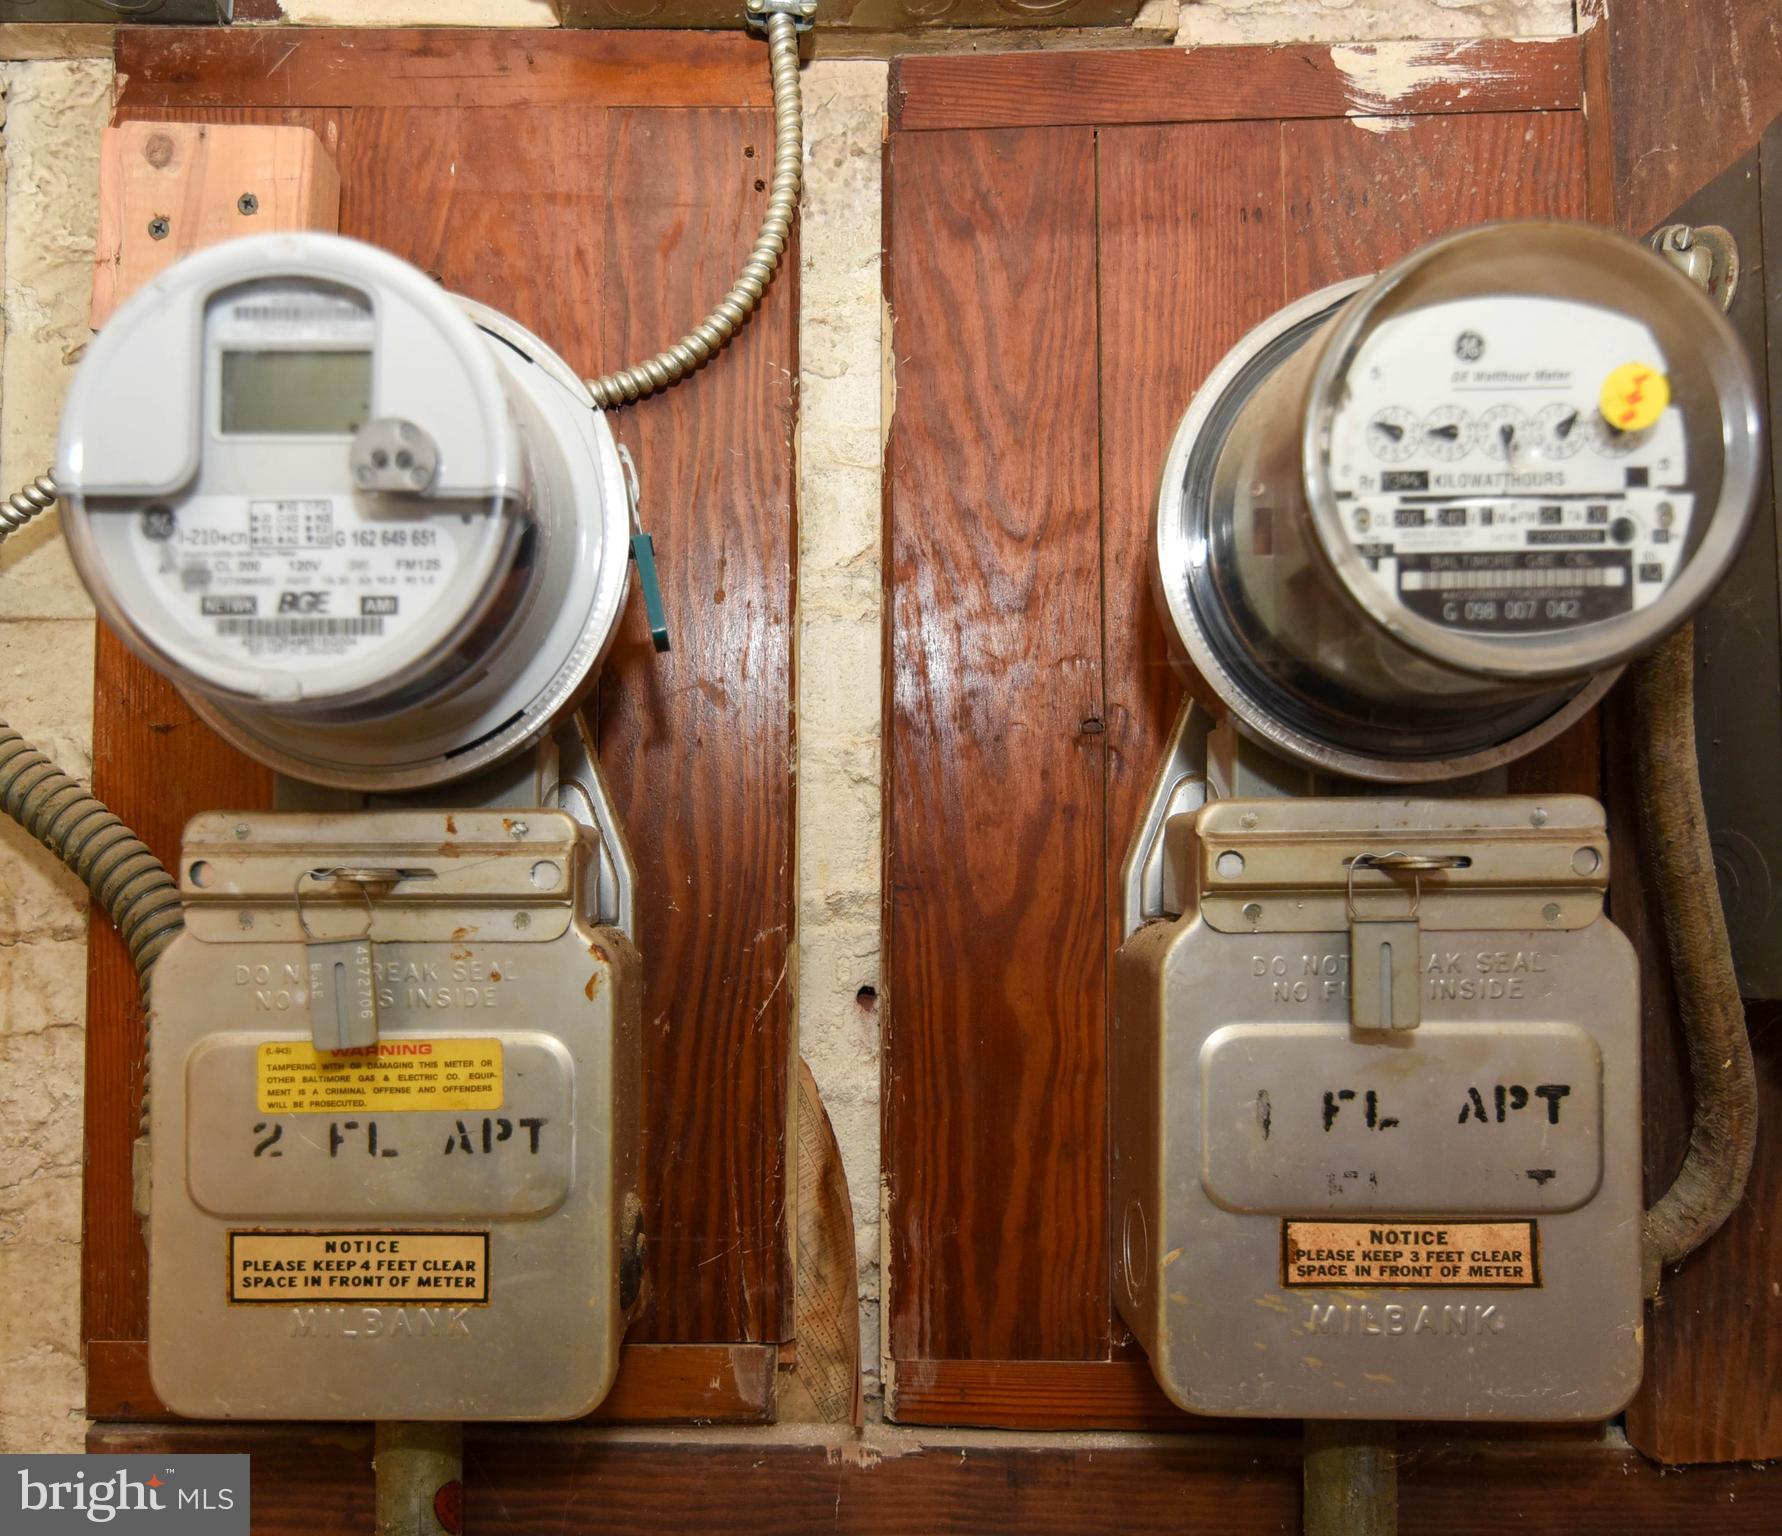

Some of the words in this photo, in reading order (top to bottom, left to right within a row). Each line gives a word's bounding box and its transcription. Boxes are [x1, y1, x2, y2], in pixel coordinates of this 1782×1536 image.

[1434, 472, 1565, 489] KILOWATTHOURS
[336, 530, 346, 547] G
[351, 530, 377, 547] 162
[381, 530, 408, 547] 649
[411, 530, 437, 547] 651
[1430, 554, 1515, 570] BALTIMORE
[277, 590, 332, 614] BGE
[364, 597, 396, 613] AMI
[1443, 602, 1457, 620] G
[1464, 602, 1496, 620] 098
[1504, 601, 1537, 619] 007
[1545, 600, 1579, 618] 042
[1252, 955, 1288, 976] DO
[1476, 952, 1547, 974] SEAL
[235, 963, 270, 985] DO
[374, 962, 438, 982] REAK
[452, 961, 518, 982] SEAL
[355, 945, 374, 1018] 4572706
[1272, 980, 1309, 1002] NO
[1430, 978, 1524, 1000] INSIDE
[256, 989, 290, 1012] NO
[407, 987, 497, 1009] INSIDE
[332, 1043, 433, 1057] WARNING
[266, 1063, 317, 1072] TAMPERING
[322, 1062, 345, 1071] WITH
[350, 1062, 362, 1070] OR
[367, 1061, 414, 1070] DAMAGING
[419, 1060, 439, 1069] THIS
[444, 1060, 474, 1068] METER
[480, 1059, 493, 1068] OR
[266, 1076, 295, 1084] OTHER
[302, 1075, 351, 1083] BALTIMORE
[358, 1074, 375, 1082] GAS
[383, 1074, 390, 1082] &
[398, 1073, 438, 1082] ELECTRIC
[446, 1073, 461, 1081] CO.
[469, 1072, 498, 1080] EQUIP-
[267, 1089, 291, 1097] MENT
[299, 1088, 306, 1096] IS
[325, 1087, 367, 1095] CRIMINAL
[373, 1087, 411, 1095] OFFENSE
[418, 1086, 436, 1094] AND
[442, 1085, 493, 1093] OFFENDERS
[267, 1101, 288, 1109] WILL
[293, 1100, 304, 1108] BE
[309, 1099, 367, 1108] PROSECUTED.
[1322, 1088, 1400, 1132] FL
[1458, 1084, 1572, 1125] APT
[253, 1121, 284, 1159] 2
[329, 1121, 399, 1159] FL
[444, 1117, 549, 1156] APT
[1369, 1229, 1449, 1245] NOTICE
[324, 1239, 401, 1254] NOTICE
[1295, 1250, 1356, 1262] PLEASE
[1362, 1250, 1404, 1262] KEEP
[1409, 1251, 1421, 1262] 3
[1426, 1250, 1465, 1262] FEET
[1470, 1251, 1523, 1262] CLEAR
[242, 1260, 307, 1272] PLEASE
[313, 1260, 357, 1272] KEEP
[360, 1260, 372, 1272] 4
[376, 1260, 418, 1272] FEET
[422, 1260, 477, 1272] CLEAR
[1296, 1264, 1348, 1277] SPACE
[1354, 1265, 1372, 1277] IN
[1379, 1265, 1433, 1277] FRONT
[1440, 1265, 1461, 1277] OF
[1468, 1265, 1524, 1277] METER
[242, 1275, 298, 1288] SPACE
[304, 1275, 322, 1288] IN
[328, 1275, 385, 1288] FRONT
[389, 1275, 412, 1288] OF
[416, 1275, 477, 1288] METER
[289, 1308, 471, 1339] MILBANK
[1309, 1304, 1500, 1336] MILBANK
